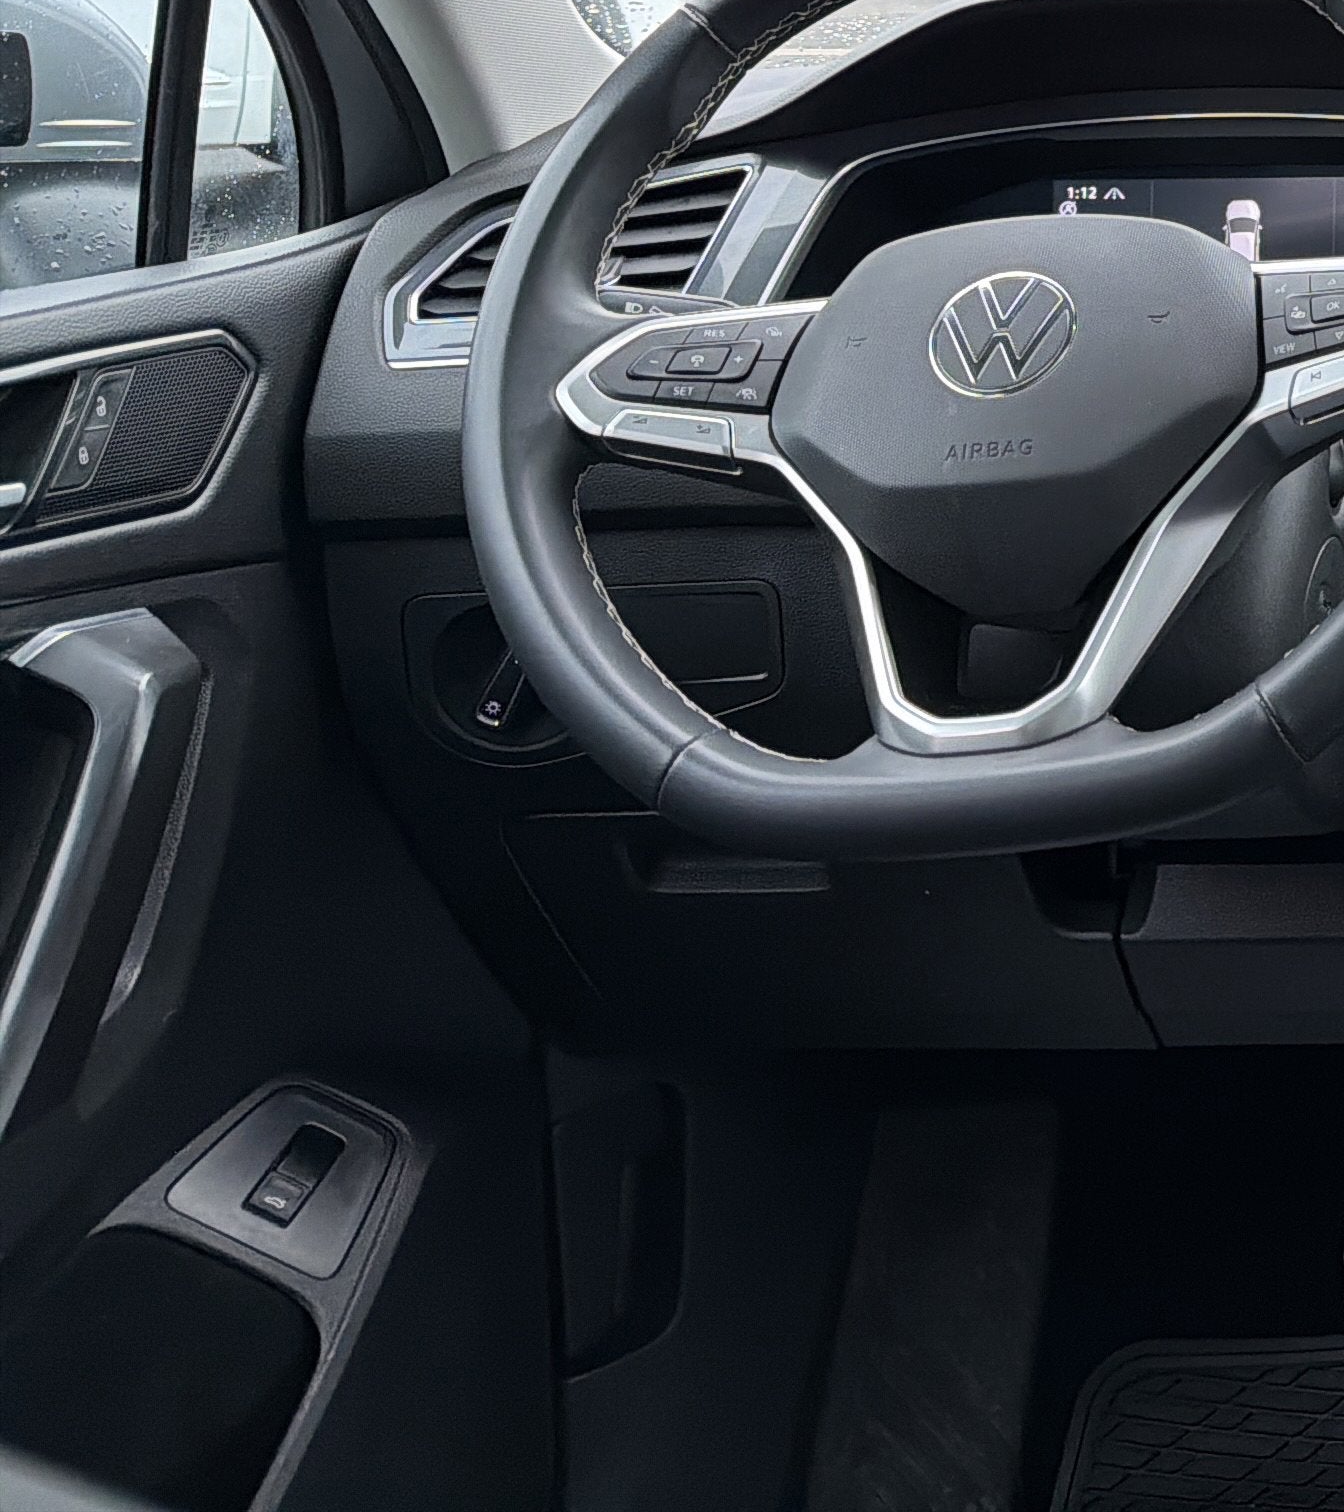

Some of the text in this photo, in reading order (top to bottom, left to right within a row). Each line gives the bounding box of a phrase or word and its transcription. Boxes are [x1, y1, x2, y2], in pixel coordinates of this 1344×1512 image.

[1066, 186, 1097, 200] 1:12
[1326, 301, 1340, 311] OK
[703, 328, 726, 338] RES
[1273, 342, 1296, 355] VIEW
[673, 387, 694, 397] SET
[944, 438, 1034, 462] AIRBAG
